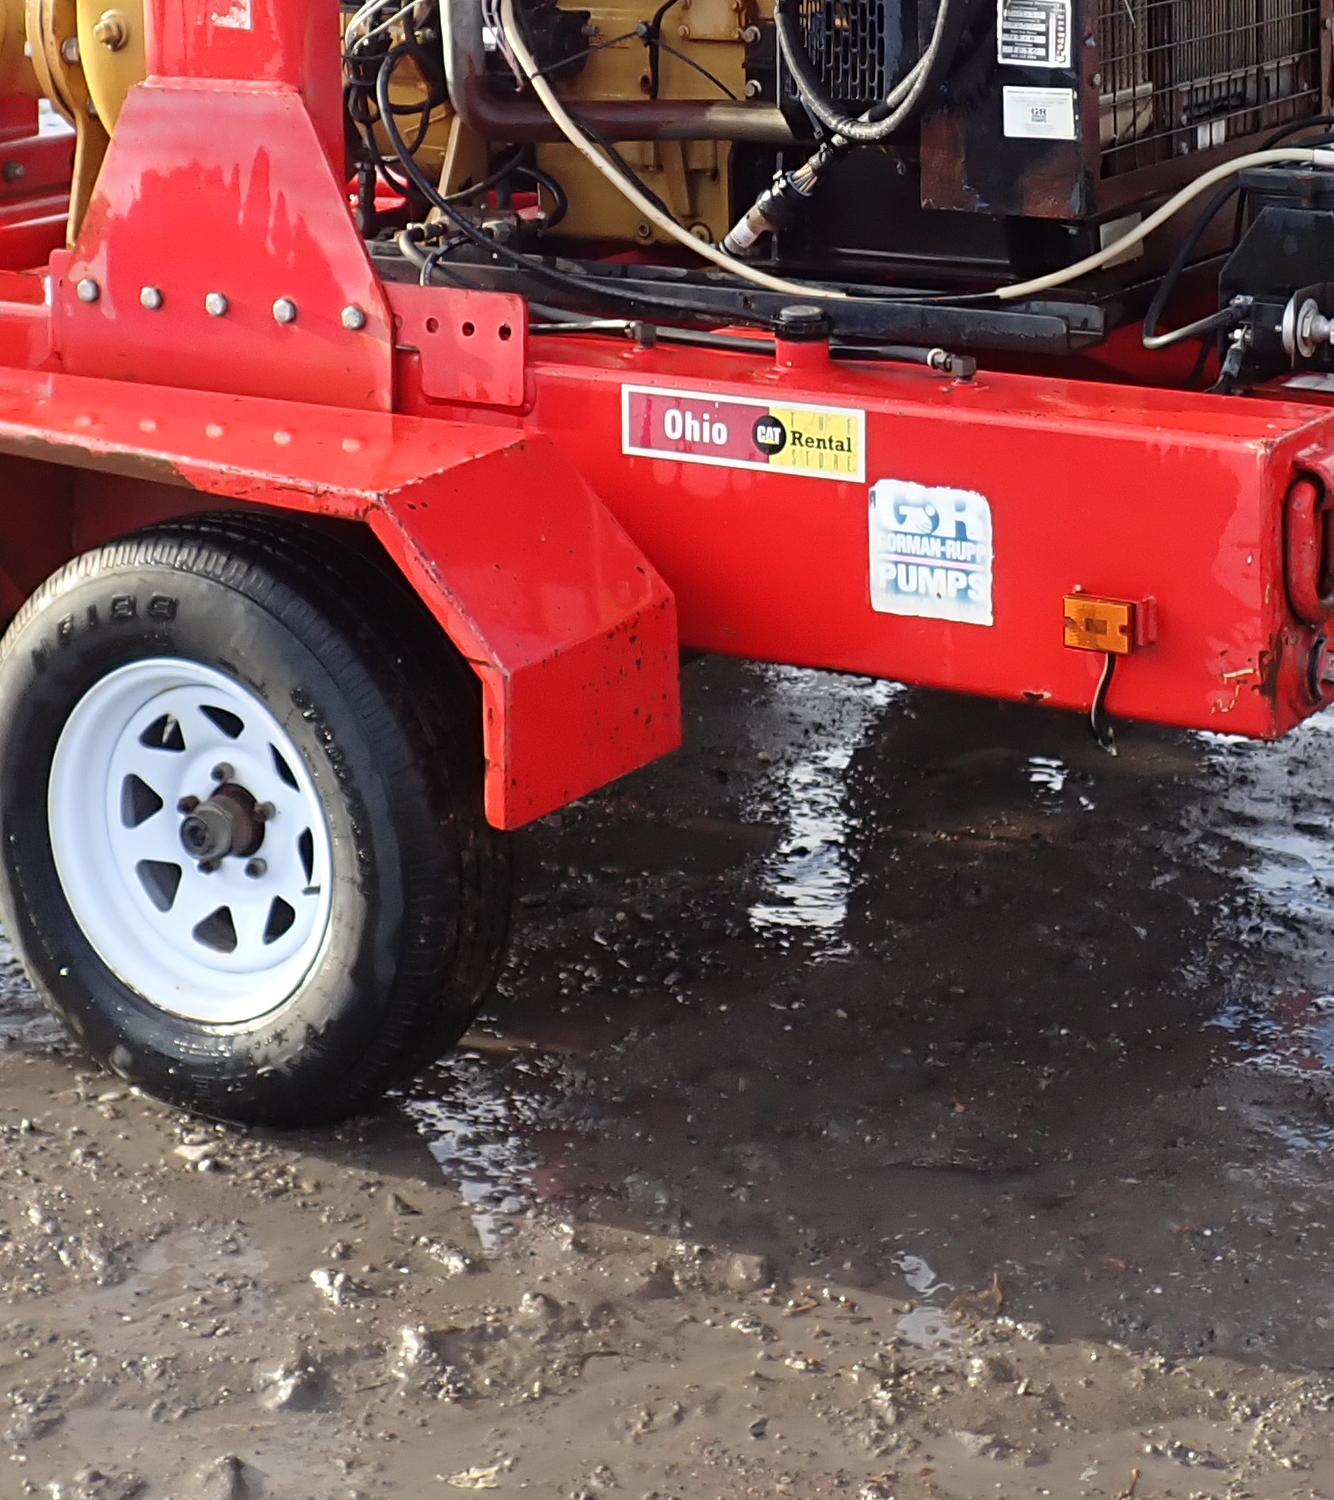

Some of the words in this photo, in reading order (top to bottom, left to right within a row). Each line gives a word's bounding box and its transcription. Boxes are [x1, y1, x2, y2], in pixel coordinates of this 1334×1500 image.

[663, 408, 728, 446] Ohio
[756, 424, 782, 446] CAT
[790, 430, 853, 453] Rental
[880, 531, 987, 562] ORMAN-RUPP
[878, 562, 988, 601] PUMPS
